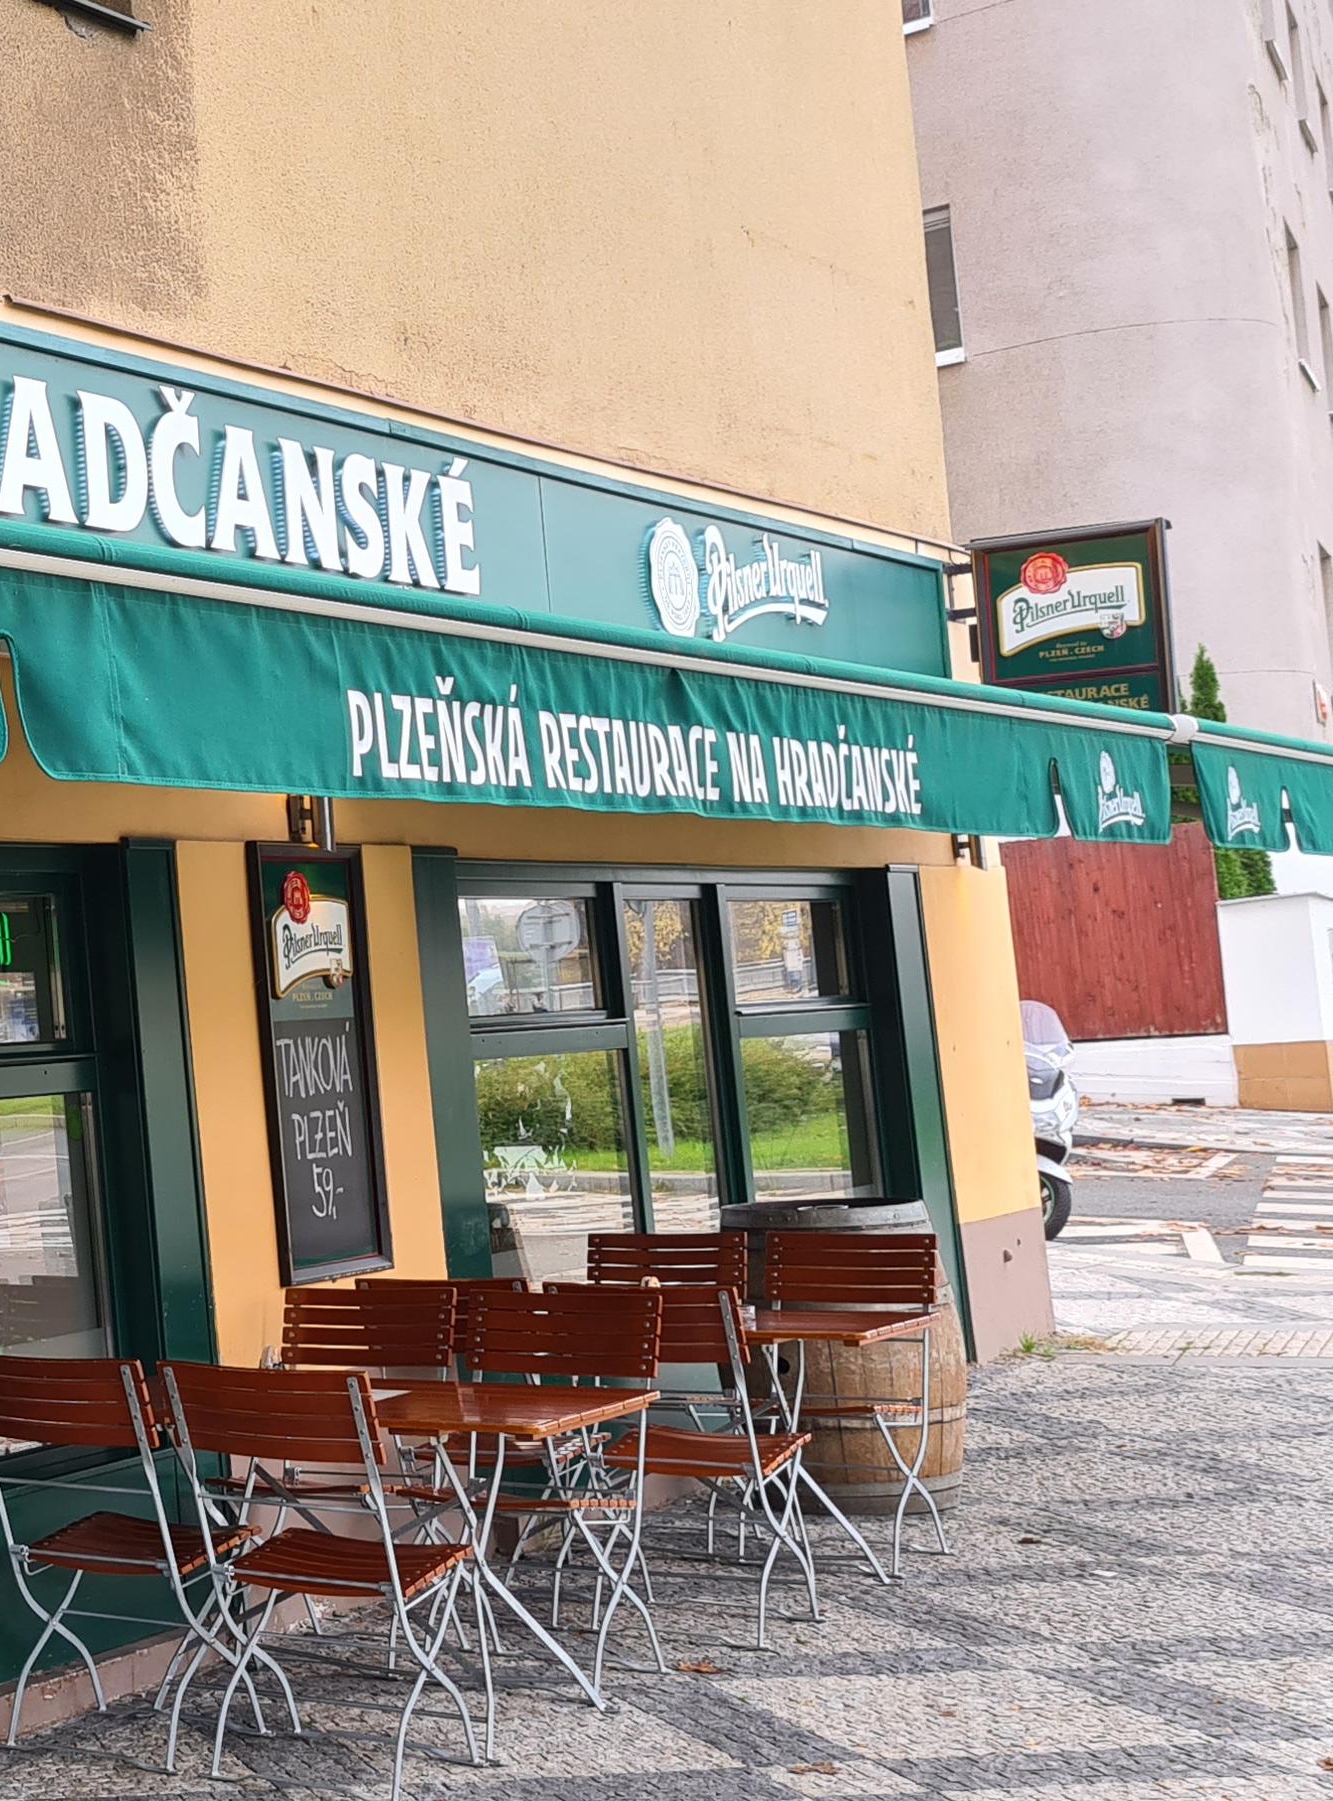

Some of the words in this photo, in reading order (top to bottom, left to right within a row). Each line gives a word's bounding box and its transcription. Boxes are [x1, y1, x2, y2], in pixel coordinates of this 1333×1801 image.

[704, 525, 767, 643] Pilsner
[763, 532, 825, 625] Urquell
[1012, 597, 1070, 634] Pilsner
[1067, 585, 1125, 613] Urquell
[1048, 683, 1130, 700] TAURACE
[346, 675, 531, 788] PLZEŇSKÁ
[538, 710, 720, 802] RESTAURACE
[726, 731, 770, 805] NA
[772, 723, 922, 815] HRADČANSKÉ
[283, 923, 313, 970] Pilsner
[311, 922, 343, 957] Urquell
[276, 1021, 353, 1098] TANKOVÁ
[291, 1100, 352, 1161] PLZEŇ
